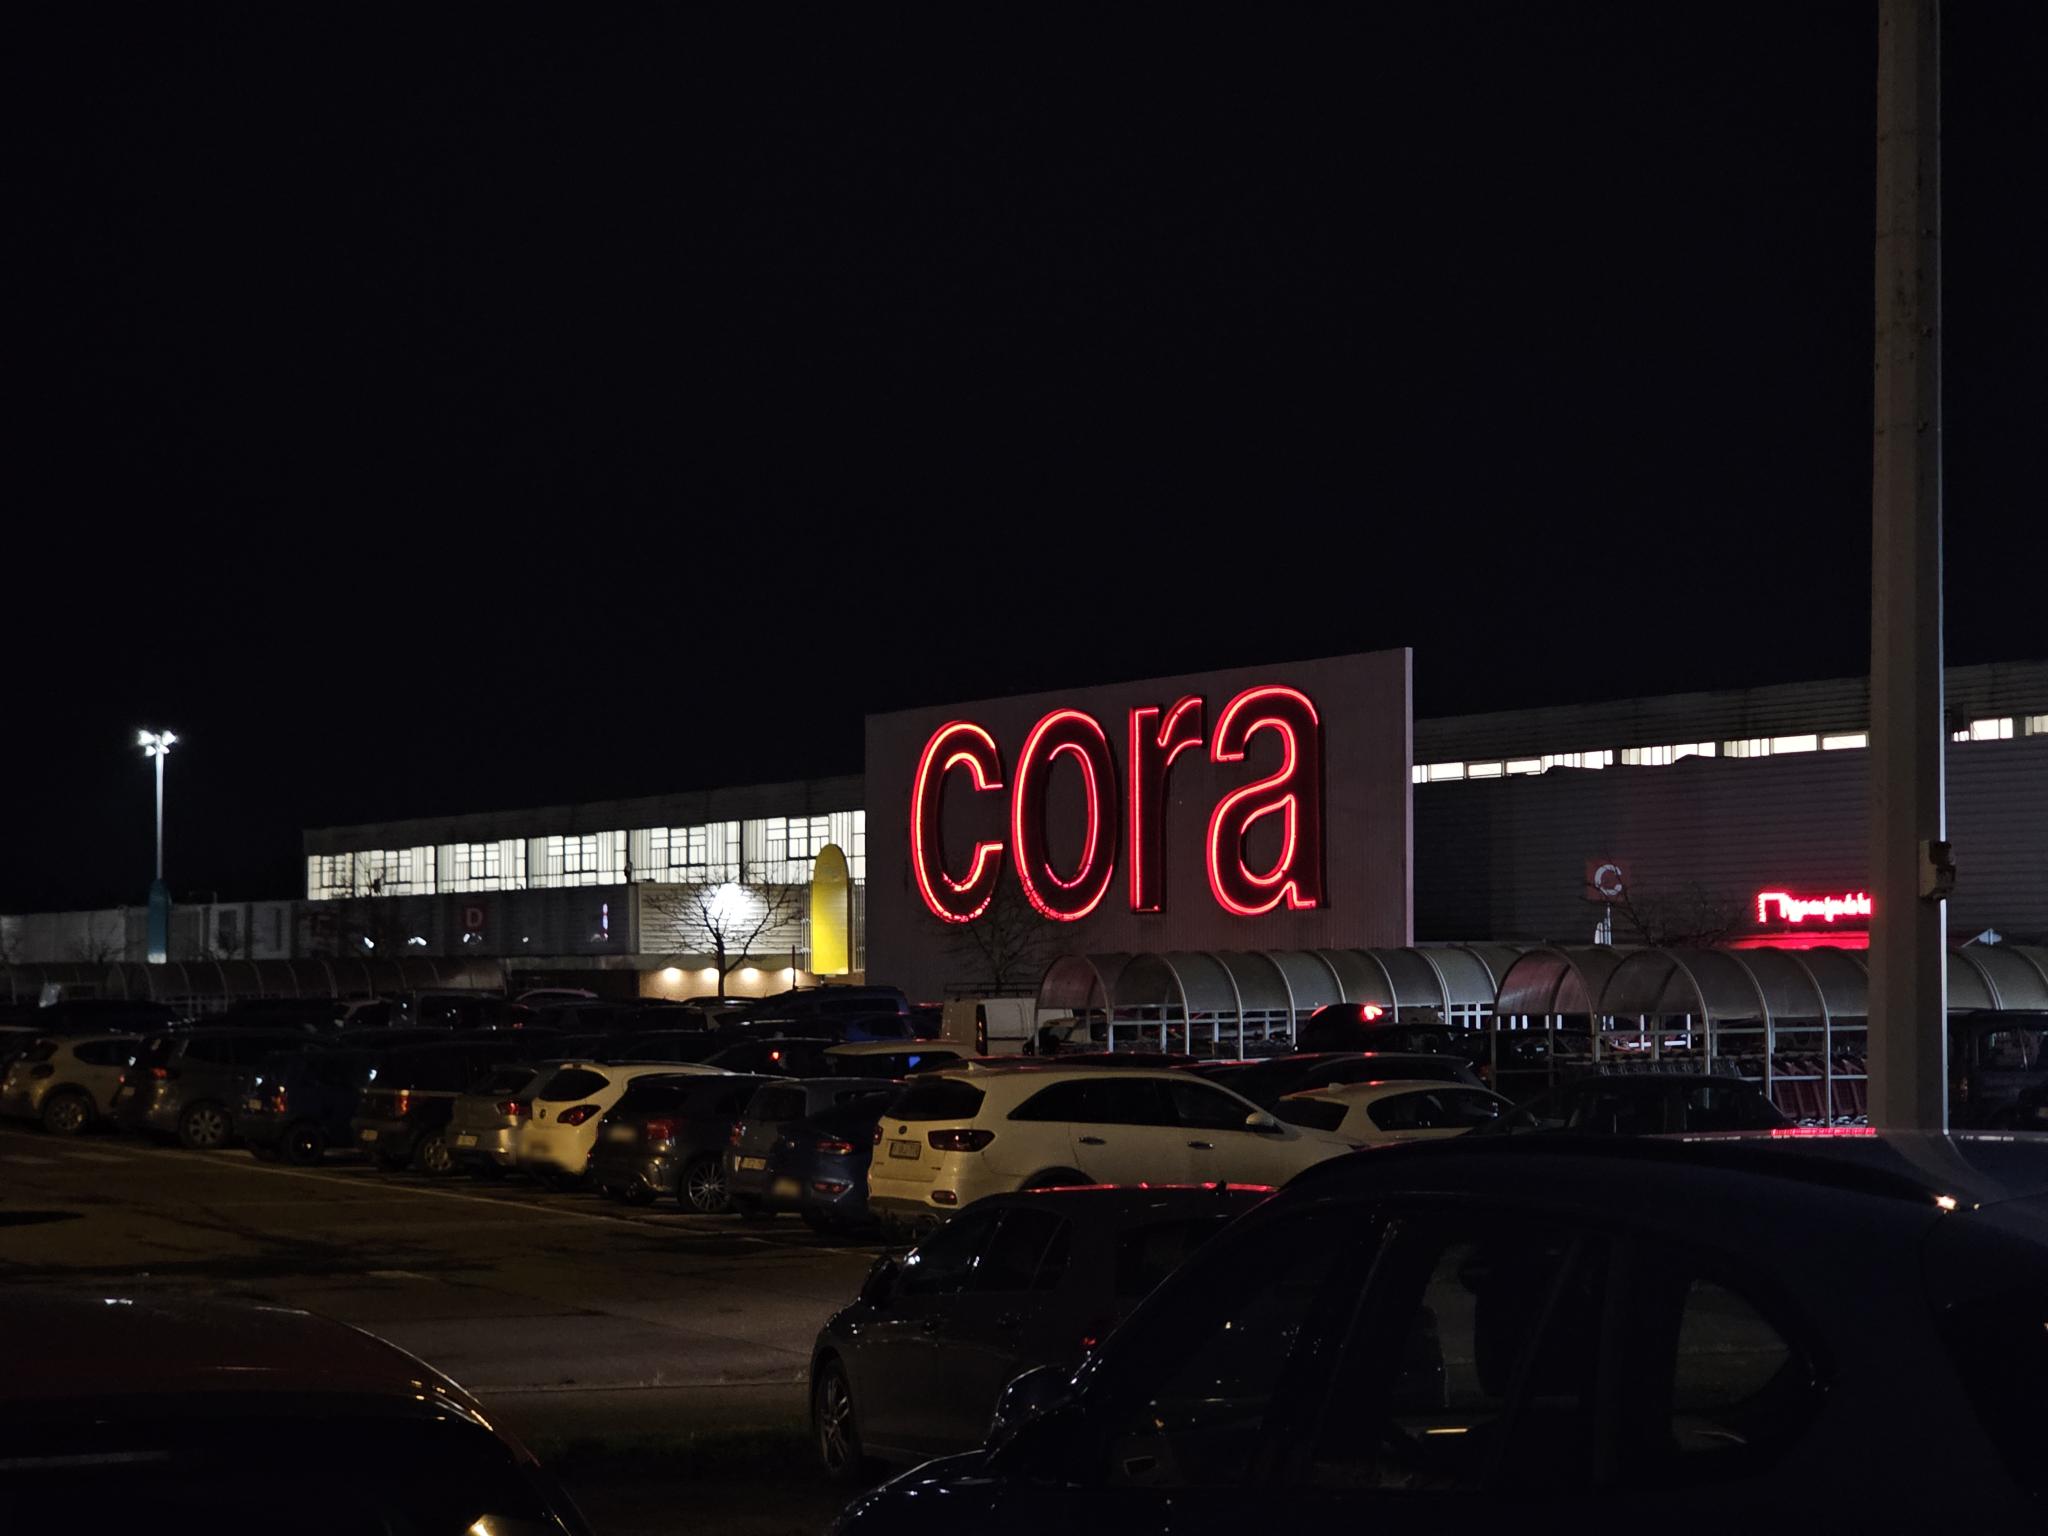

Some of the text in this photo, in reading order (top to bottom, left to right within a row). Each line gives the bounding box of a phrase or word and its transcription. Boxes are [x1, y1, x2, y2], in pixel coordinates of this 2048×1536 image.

[910, 684, 1324, 923] cora
[1594, 864, 1622, 896] C
[466, 908, 483, 927] D
